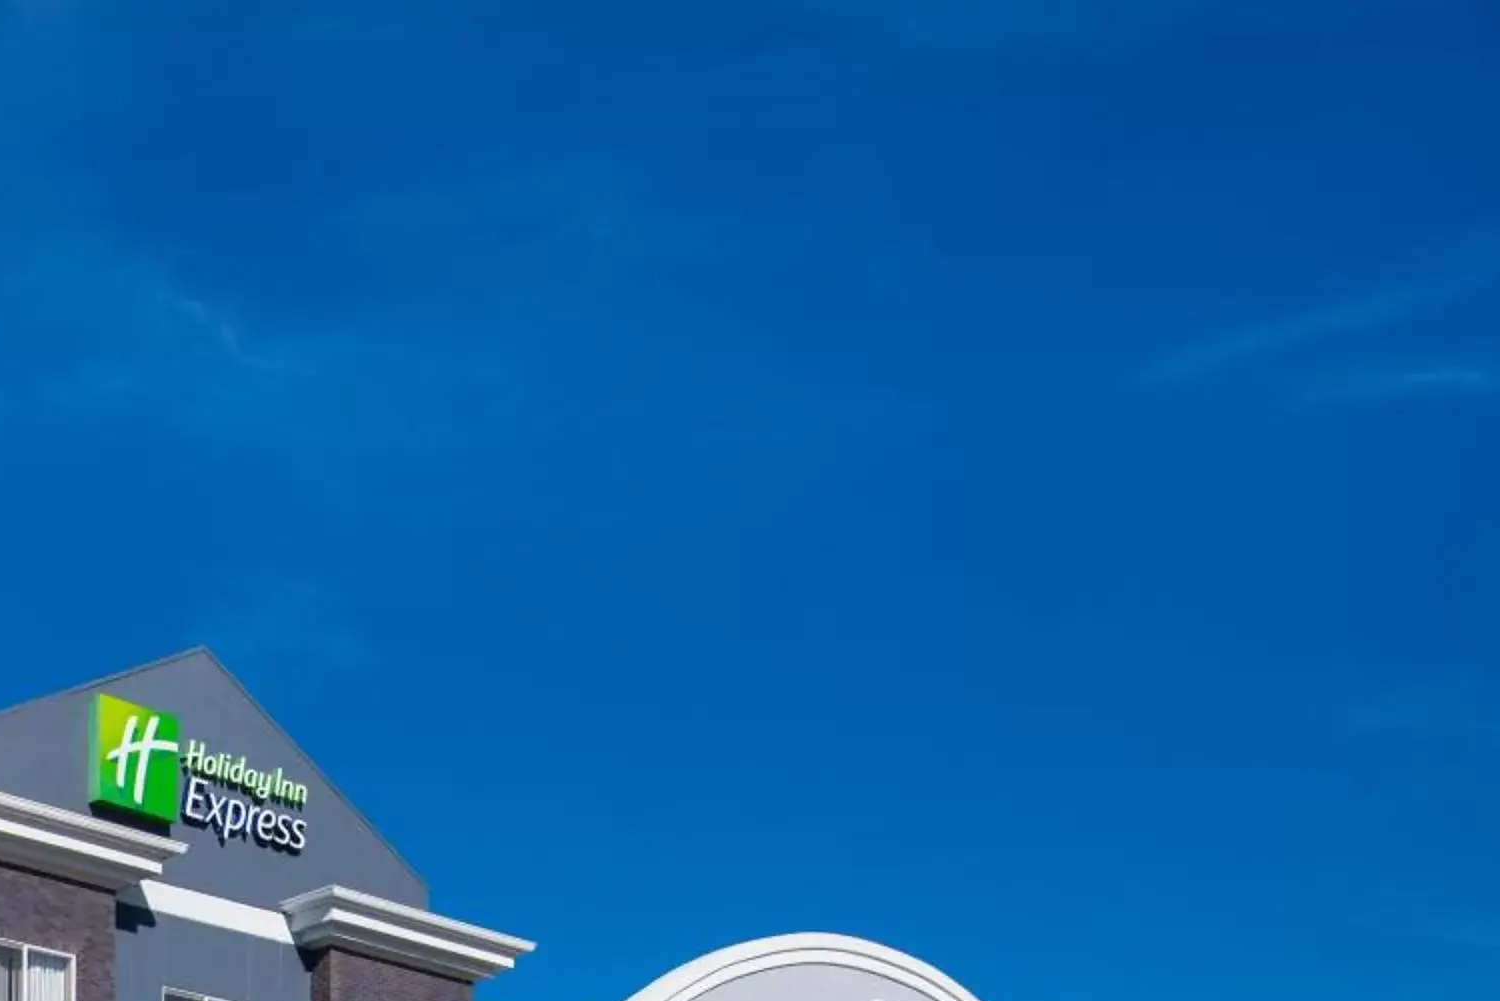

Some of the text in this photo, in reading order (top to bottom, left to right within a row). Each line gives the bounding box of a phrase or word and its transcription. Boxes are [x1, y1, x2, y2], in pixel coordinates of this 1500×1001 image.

[187, 739, 307, 804] Holiday Inn
[185, 778, 307, 849] Express
